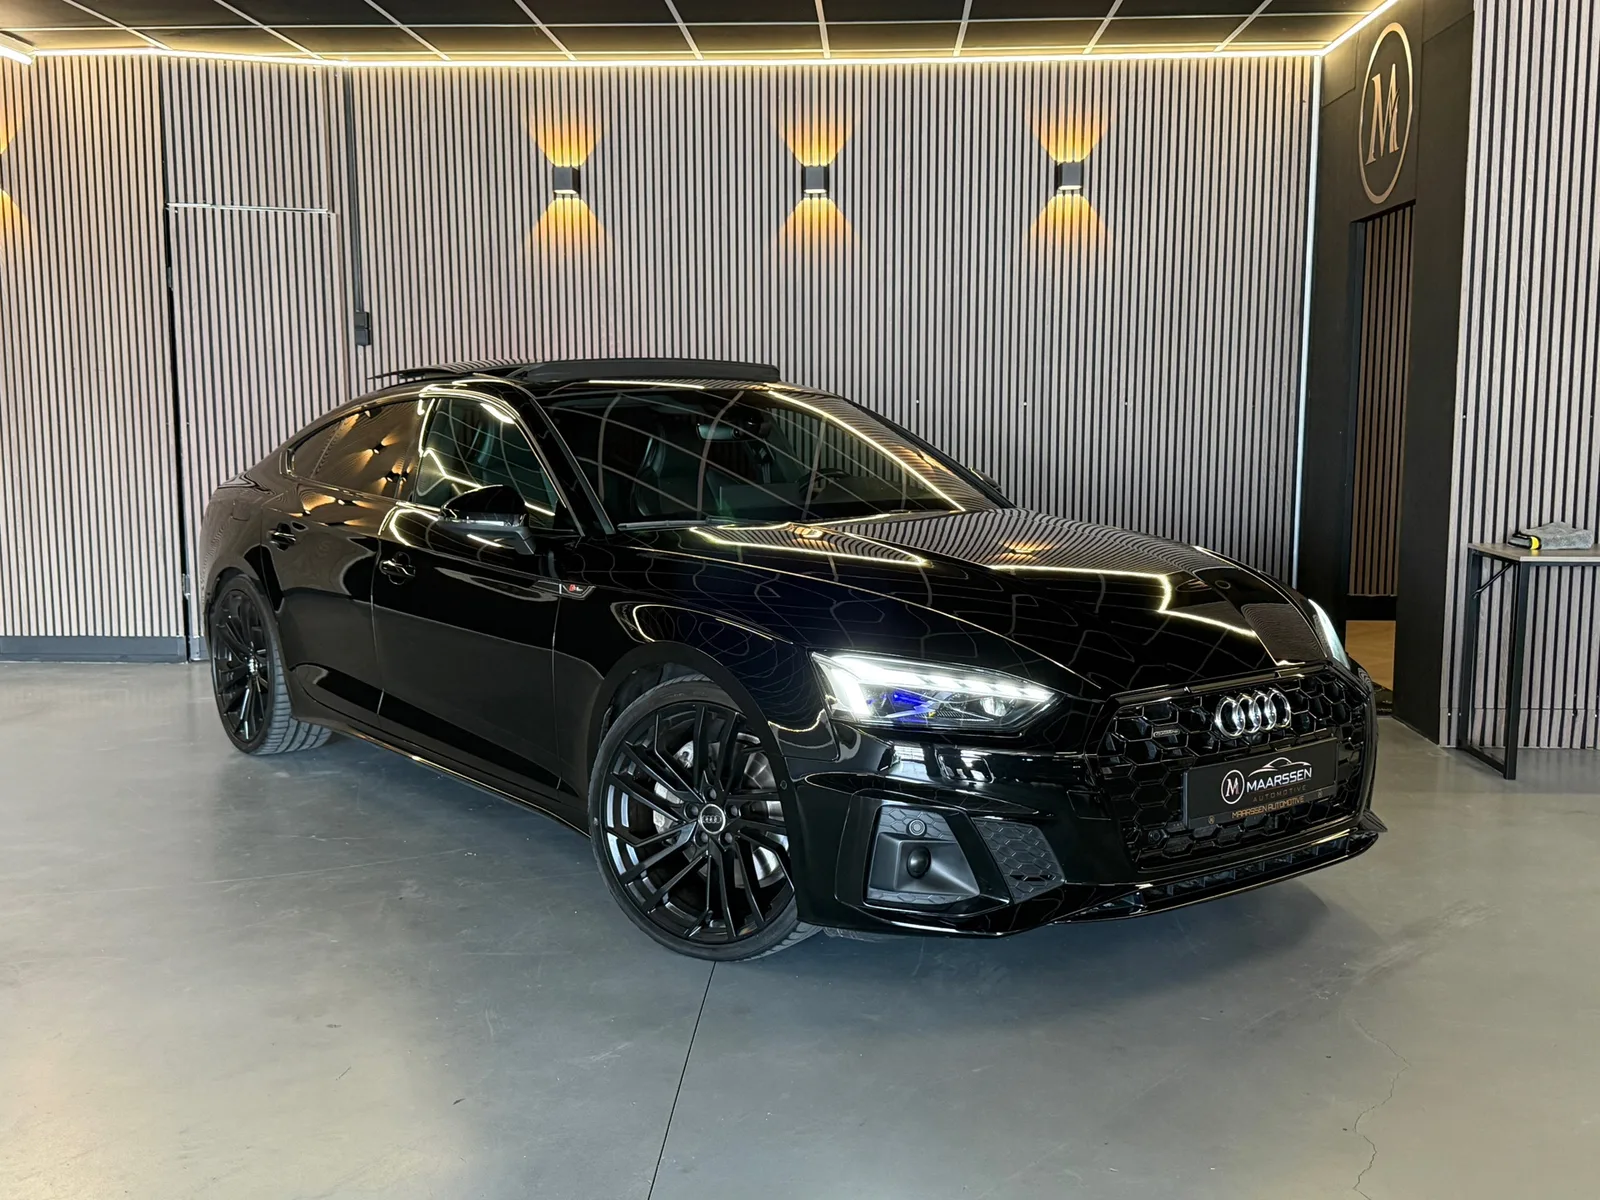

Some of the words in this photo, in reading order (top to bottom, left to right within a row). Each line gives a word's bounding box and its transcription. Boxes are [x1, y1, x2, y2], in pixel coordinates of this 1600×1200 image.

[1246, 767, 1312, 793] MAARSSEN
[1252, 784, 1307, 803] AUTOMOTIVE
[1231, 804, 1267, 819] MAARSSEN
[1267, 795, 1305, 811] AUTOMOTIVE
